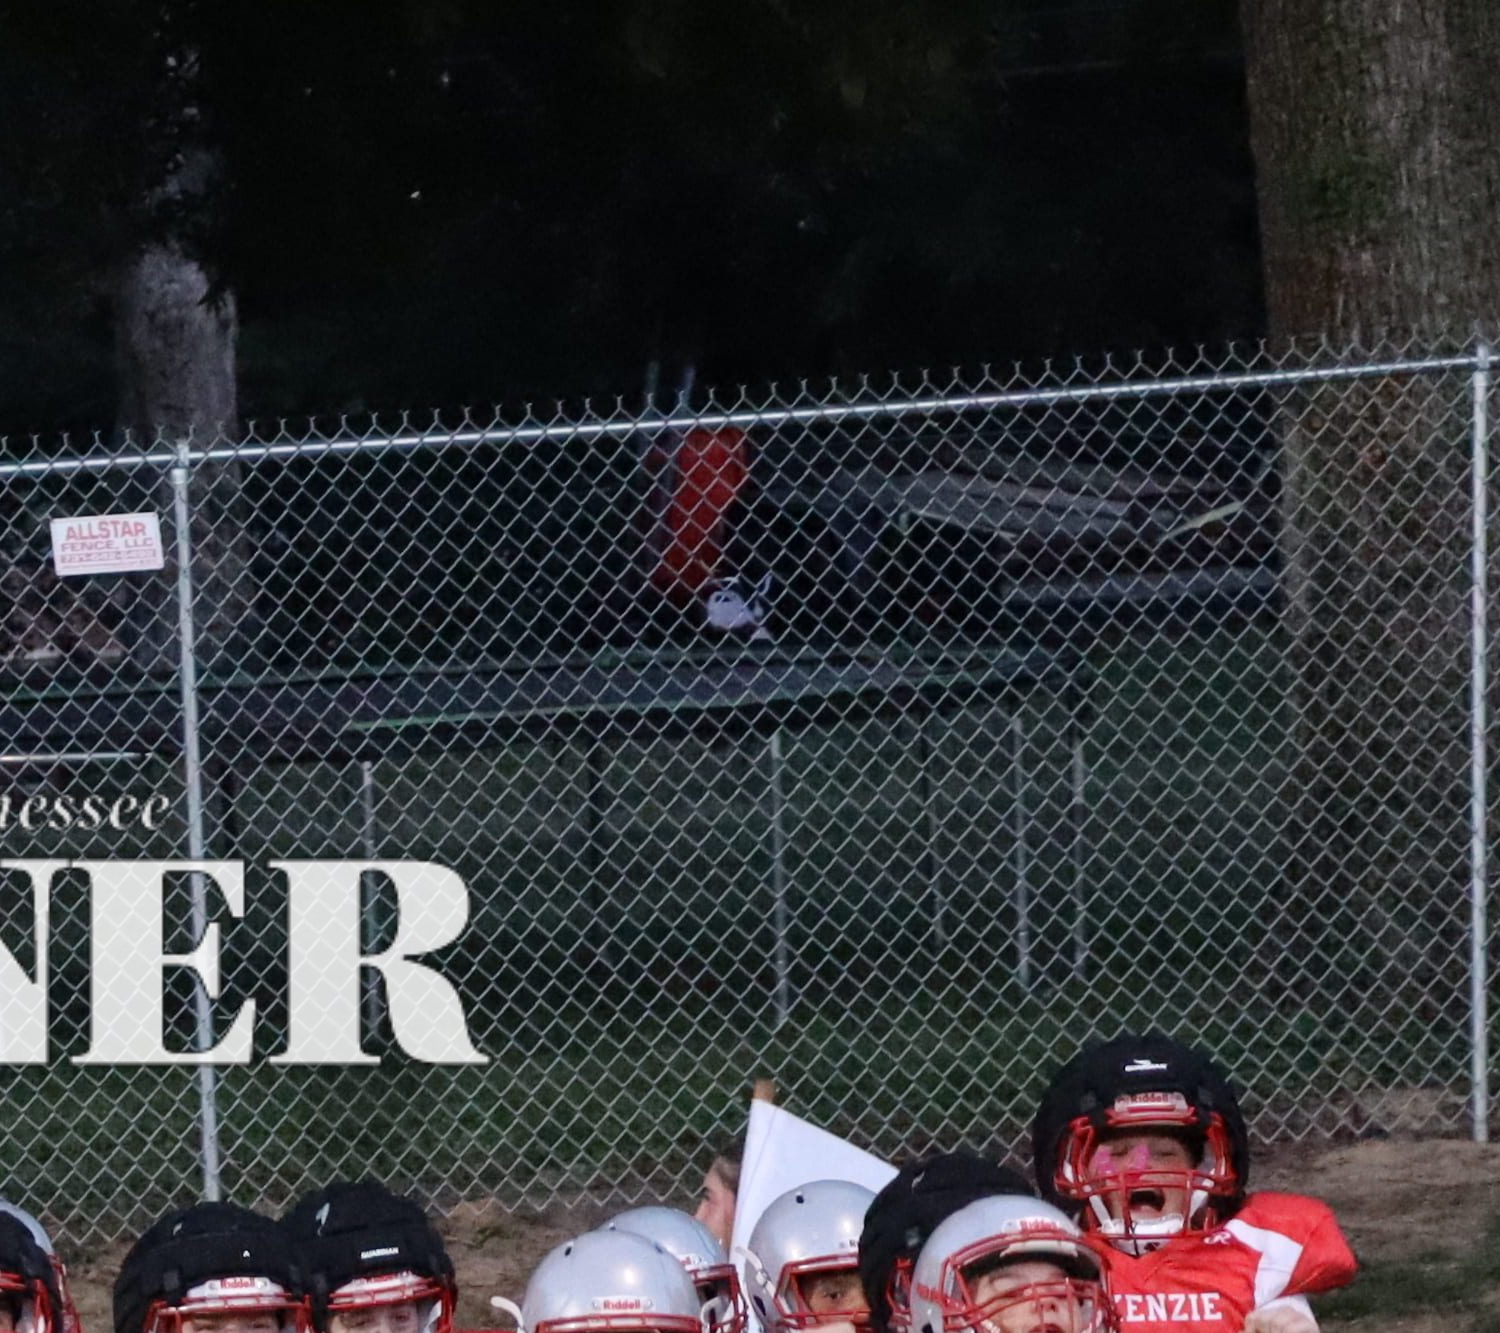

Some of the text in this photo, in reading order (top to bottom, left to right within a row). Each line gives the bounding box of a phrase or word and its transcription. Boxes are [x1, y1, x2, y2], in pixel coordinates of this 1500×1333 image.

[65, 520, 147, 541] ALLSTAR
[124, 537, 155, 548] LLC
[603, 1298, 642, 1311] Riddell
[1113, 1292, 1223, 1322] ENZIE
